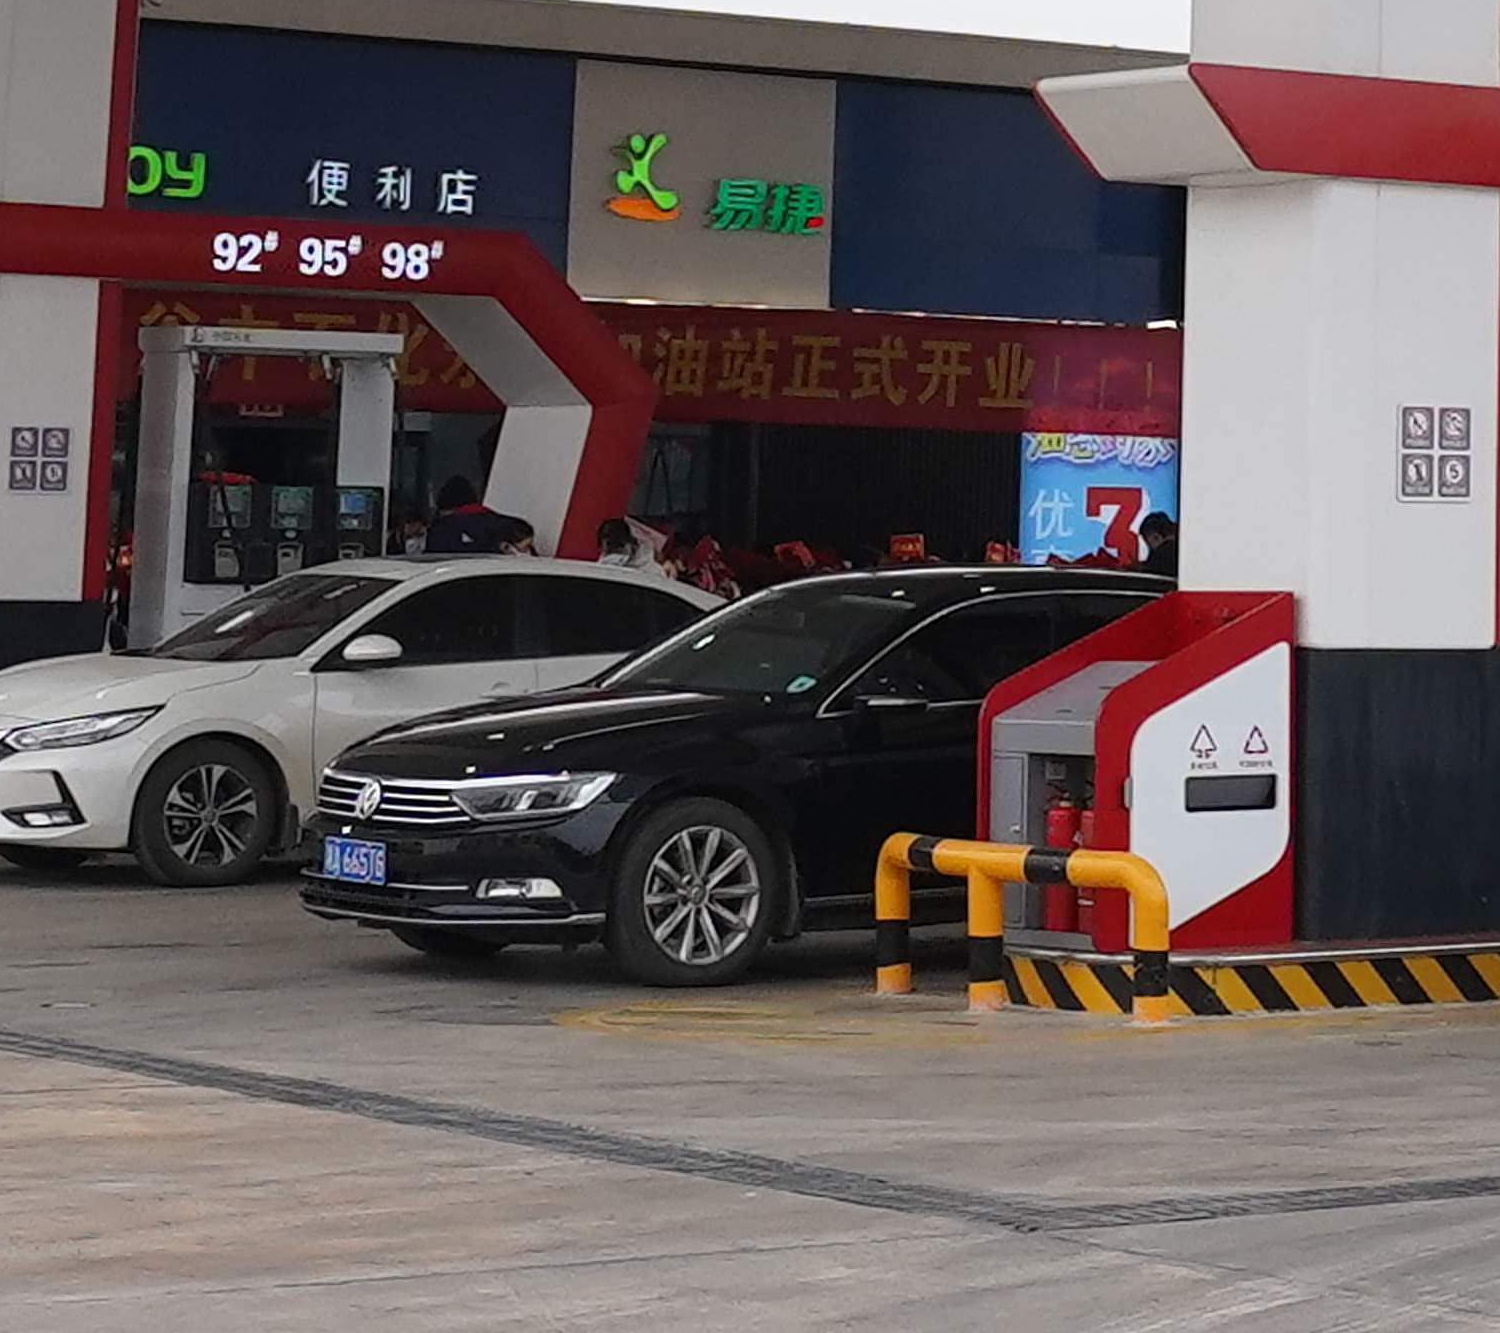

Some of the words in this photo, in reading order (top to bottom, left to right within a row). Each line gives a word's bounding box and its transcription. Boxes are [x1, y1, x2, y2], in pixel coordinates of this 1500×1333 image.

[306, 158, 479, 215] 便利店
[708, 178, 825, 236] 易捷
[1028, 488, 1077, 564] 优
